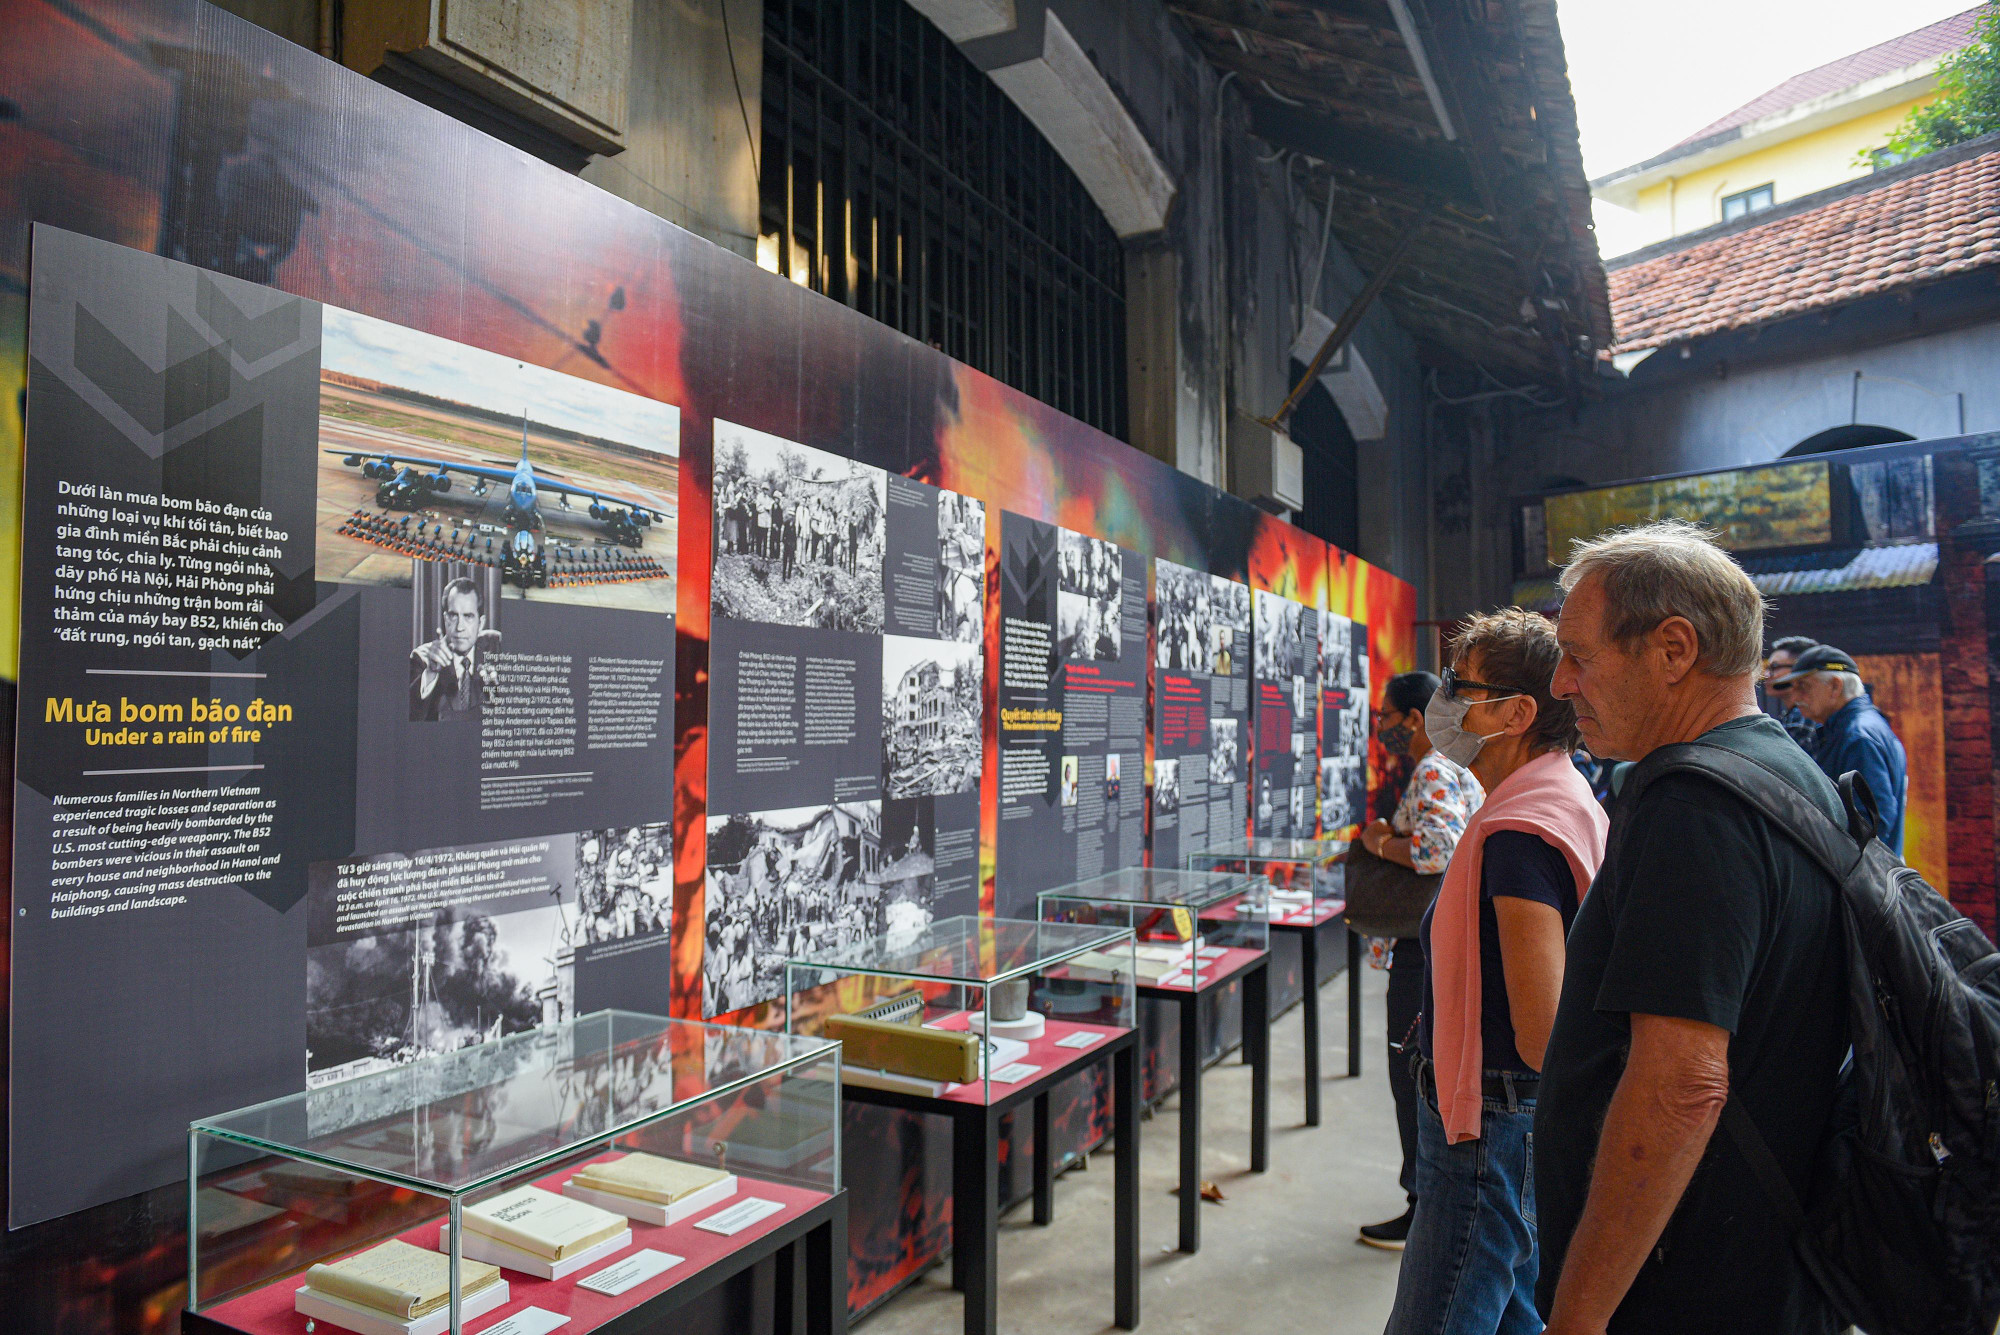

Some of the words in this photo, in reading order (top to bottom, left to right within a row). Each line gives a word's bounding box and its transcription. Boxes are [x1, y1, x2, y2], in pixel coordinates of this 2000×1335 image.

[59, 481, 96, 498] Dưới
[100, 486, 122, 501] làn
[126, 493, 158, 506] mưa
[161, 494, 192, 510] bom
[196, 498, 221, 514] bão
[224, 503, 248, 520] đạn
[250, 507, 272, 521] của
[58, 502, 108, 523] những
[112, 508, 139, 526] loại
[164, 514, 186, 529] khí
[188, 517, 206, 532] tối
[209, 521, 235, 536] tân,
[238, 523, 262, 538] biết
[265, 527, 288, 541] bao
[57, 523, 81, 539] gia
[85, 526, 119, 541] đình
[123, 530, 159, 546] miền
[163, 533, 187, 549] Bắc
[190, 538, 220, 552] phải
[222, 541, 249, 558] chịu
[252, 544, 282, 559] cảnh
[56, 545, 92, 562] tang
[96, 548, 123, 564] tóc,
[127, 550, 156, 565] chia
[160, 553, 176, 570] ly.
[178, 556, 212, 574] Từng
[215, 560, 244, 575] ngôi
[247, 562, 274, 578] nhà,
[55, 564, 84, 582] dãy
[88, 568, 118, 583] phố
[122, 570, 140, 584] Hà
[144, 572, 172, 589] Nội,
[176, 574, 198, 588] Hải
[202, 577, 244, 595] Phòng
[246, 581, 274, 596] phải
[55, 585, 95, 604] hứng
[99, 589, 130, 606] chịu
[134, 592, 180, 610] những
[183, 596, 211, 612] trận
[214, 597, 244, 611] bom
[246, 599, 263, 612] rải
[54, 606, 94, 621] thảm
[98, 609, 124, 623] của
[128, 612, 159, 628] máy
[162, 612, 188, 630] bay
[190, 615, 219, 630] B52,
[222, 616, 258, 630] khiến
[261, 619, 284, 632] cho
[90, 632, 129, 646] rung,
[133, 632, 165, 648] ngói
[168, 634, 195, 648] tan,
[198, 635, 230, 650] gạch
[45, 698, 111, 722] Mưa
[120, 698, 183, 722] bom
[191, 698, 240, 722] bão
[246, 698, 292, 728] đạn
[86, 727, 148, 746] Under
[152, 732, 164, 744] a
[168, 726, 205, 744] rain
[209, 726, 229, 744] of
[231, 726, 261, 743] fire
[53, 795, 113, 805] Numerous
[115, 790, 158, 802] families
[160, 790, 170, 800] in
[172, 788, 218, 799] Northern
[220, 786, 260, 796] Vietnam
[53, 807, 123, 823] experienced
[125, 806, 157, 819] tragic
[158, 804, 189, 815] losses
[190, 802, 211, 813] and
[212, 799, 264, 813] separation
[265, 800, 276, 808] as
[52, 830, 61, 838] a
[62, 825, 96, 837] result
[98, 823, 112, 834] of
[112, 822, 143, 834] being
[145, 819, 184, 831] heavily
[185, 814, 244, 828] bombarded
[244, 814, 257, 826] by
[258, 812, 273, 823] the
[52, 842, 75, 854] U.S.
[77, 841, 107, 852] most
[108, 835, 177, 850] cutting-edge
[179, 832, 231, 844] weaponry.
[234, 828, 251, 839] The
[252, 827, 271, 838] B52
[52, 857, 103, 870] bombers
[106, 856, 132, 865] were
[134, 851, 171, 862] vicious
[173, 849, 183, 859] in
[185, 846, 210, 858] their
[210, 843, 246, 856] assault
[247, 844, 260, 852] on
[52, 876, 85, 887] every
[86, 872, 120, 883] house
[122, 867, 144, 879] and
[145, 860, 220, 878] neighborhood
[220, 859, 230, 870] in
[232, 856, 261, 868] Hanoi
[262, 853, 281, 865] and
[51, 889, 112, 903] Haiphong,
[114, 883, 156, 896] causing
[158, 881, 185, 891] mass
[186, 873, 242, 888] destruction
[244, 872, 254, 881] to
[256, 869, 272, 880] the
[51, 905, 105, 919] buildings
[107, 900, 130, 912] and
[130, 896, 187, 909] landscape.
